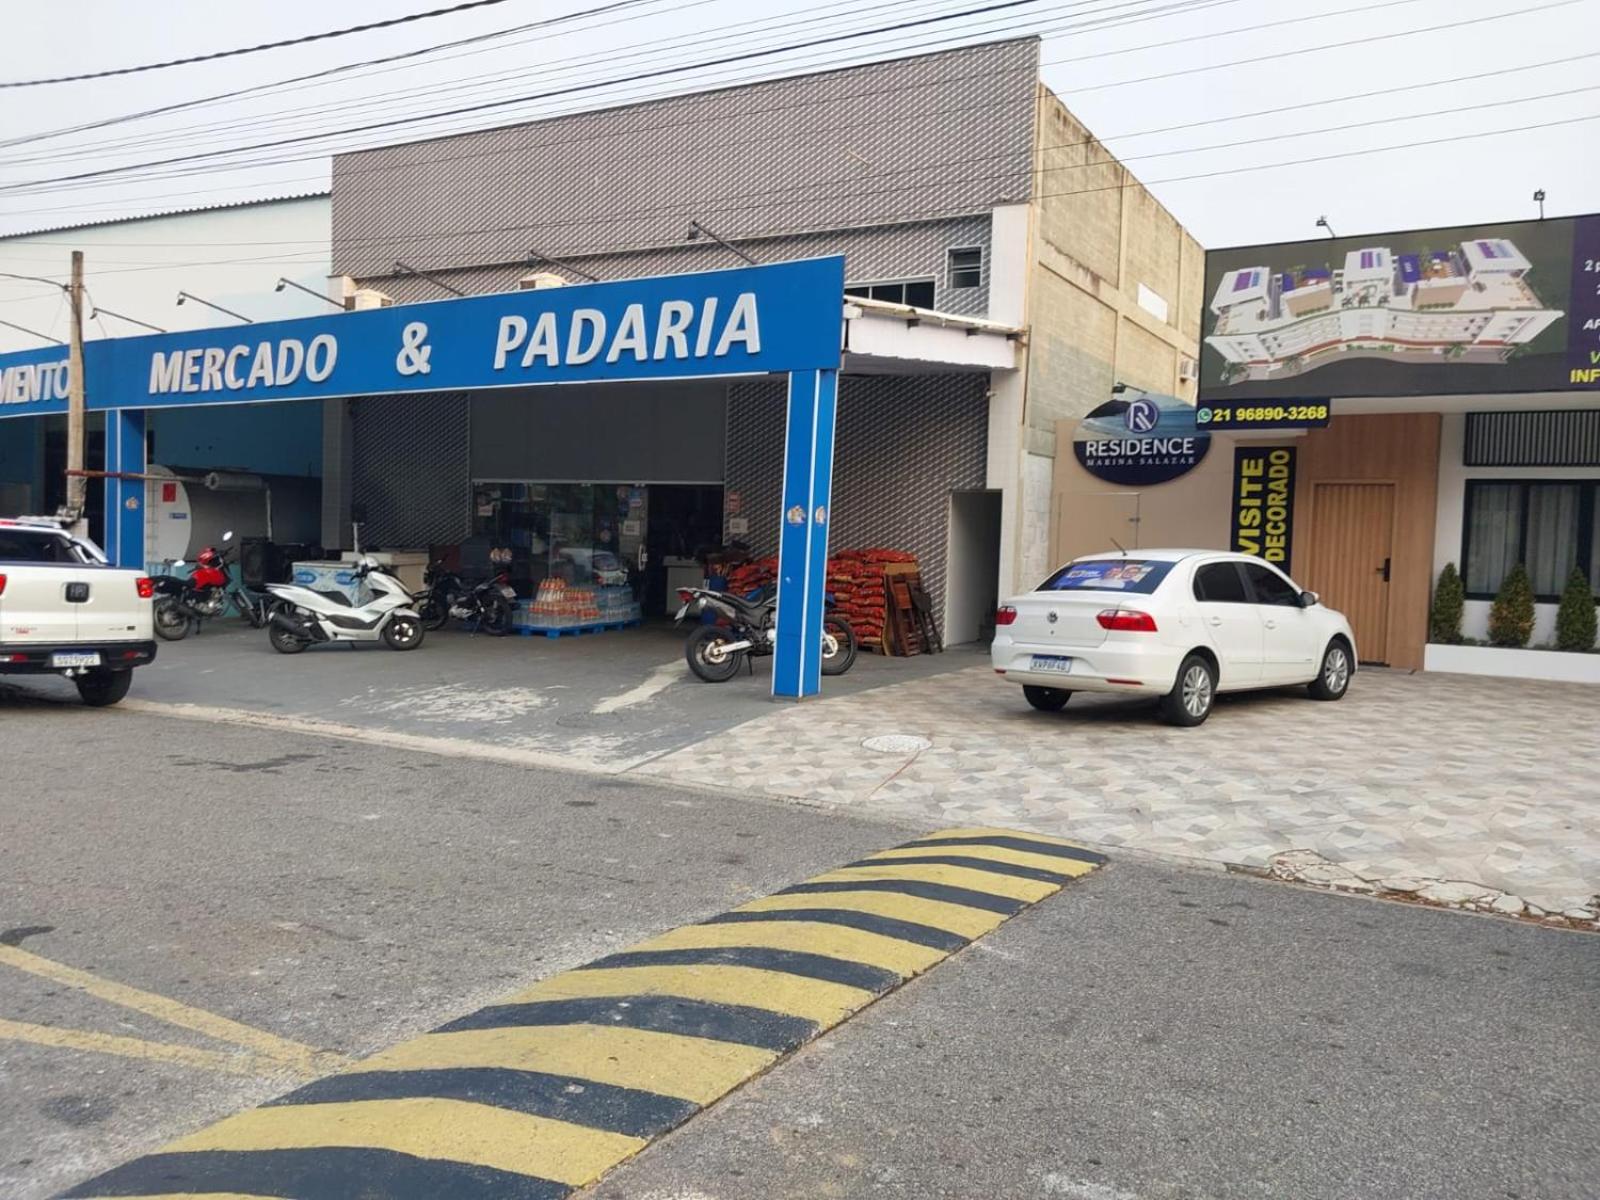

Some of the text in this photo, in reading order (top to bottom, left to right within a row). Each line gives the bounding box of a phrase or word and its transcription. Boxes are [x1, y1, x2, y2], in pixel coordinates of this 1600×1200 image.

[148, 292, 762, 395] MERCADO & PADARIA
[1086, 438, 1195, 456] RESIDENCE
[1213, 406, 1327, 421] 21 96890-3268
[1238, 459, 1264, 556] VISITE
[1264, 450, 1290, 562] DECORADO
